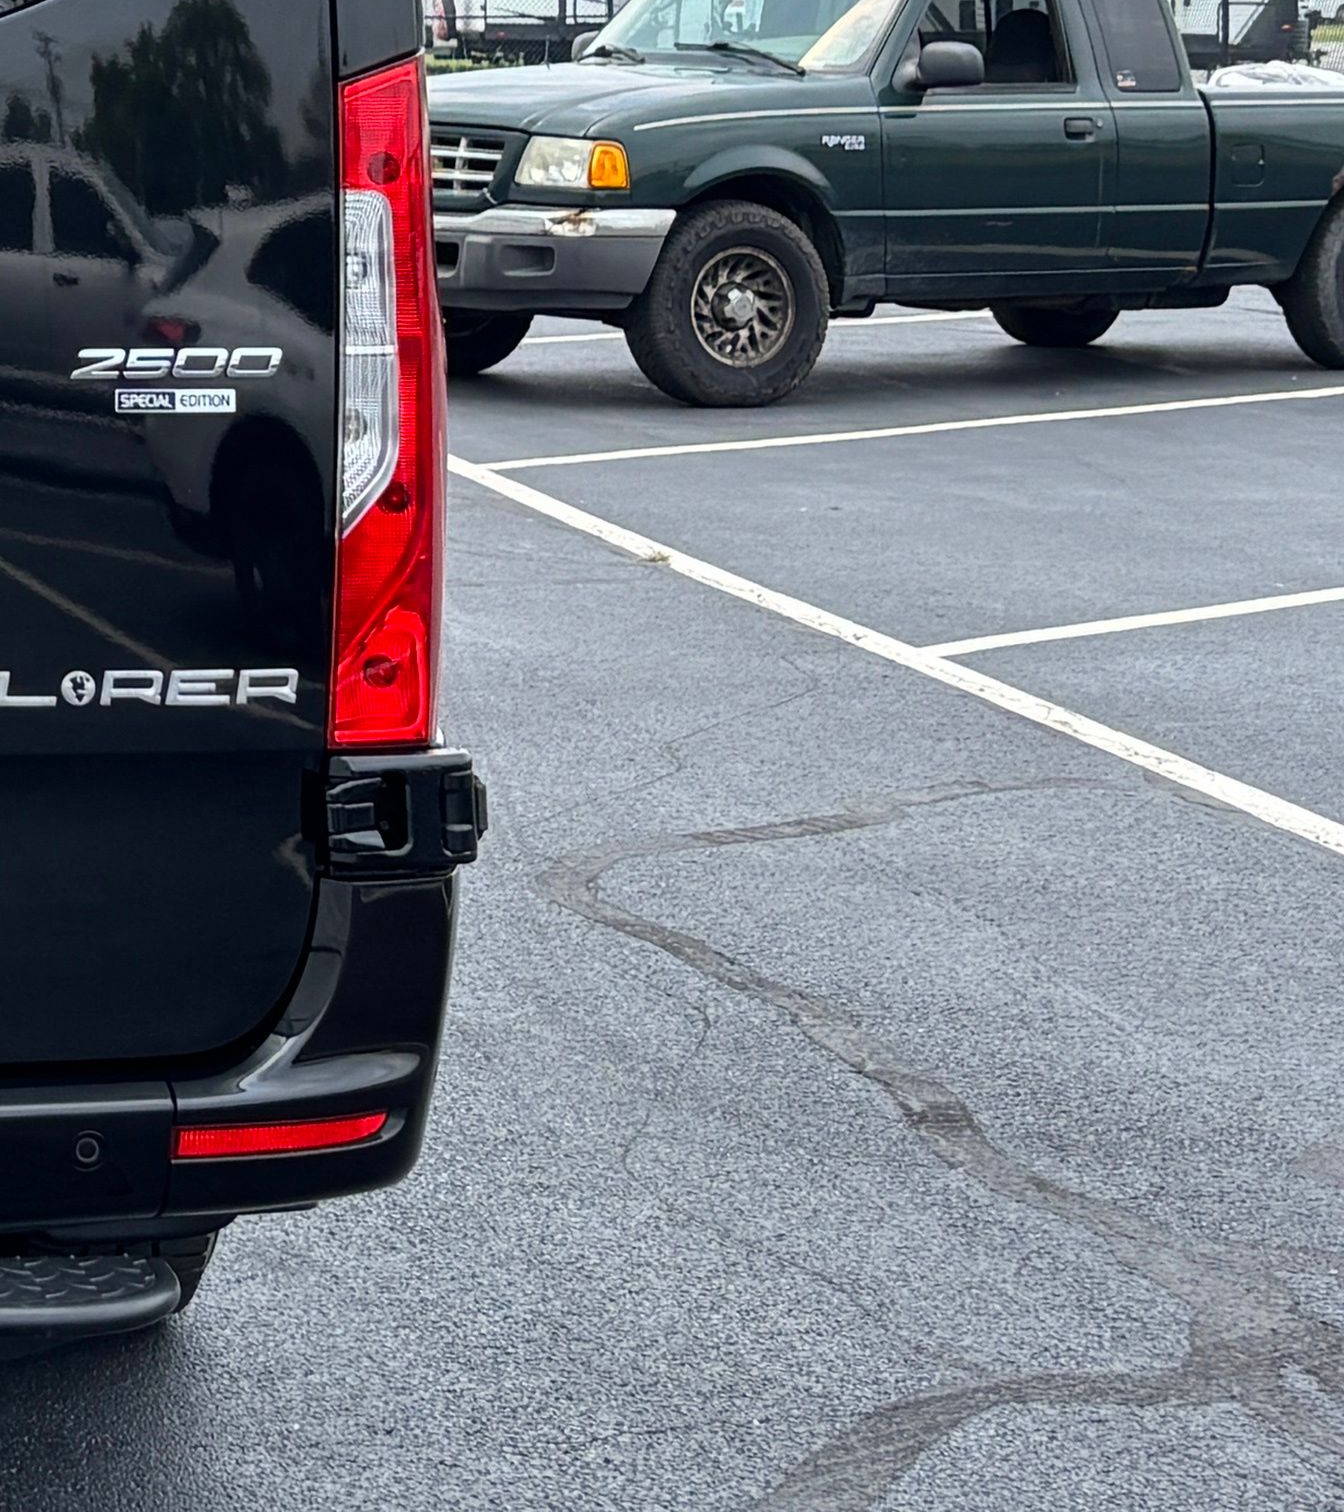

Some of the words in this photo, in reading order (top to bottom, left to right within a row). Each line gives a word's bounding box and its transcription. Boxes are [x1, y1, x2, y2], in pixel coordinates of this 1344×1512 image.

[69, 347, 283, 380] 2500
[118, 393, 174, 409] SPECIAL
[179, 393, 231, 408] EDITION
